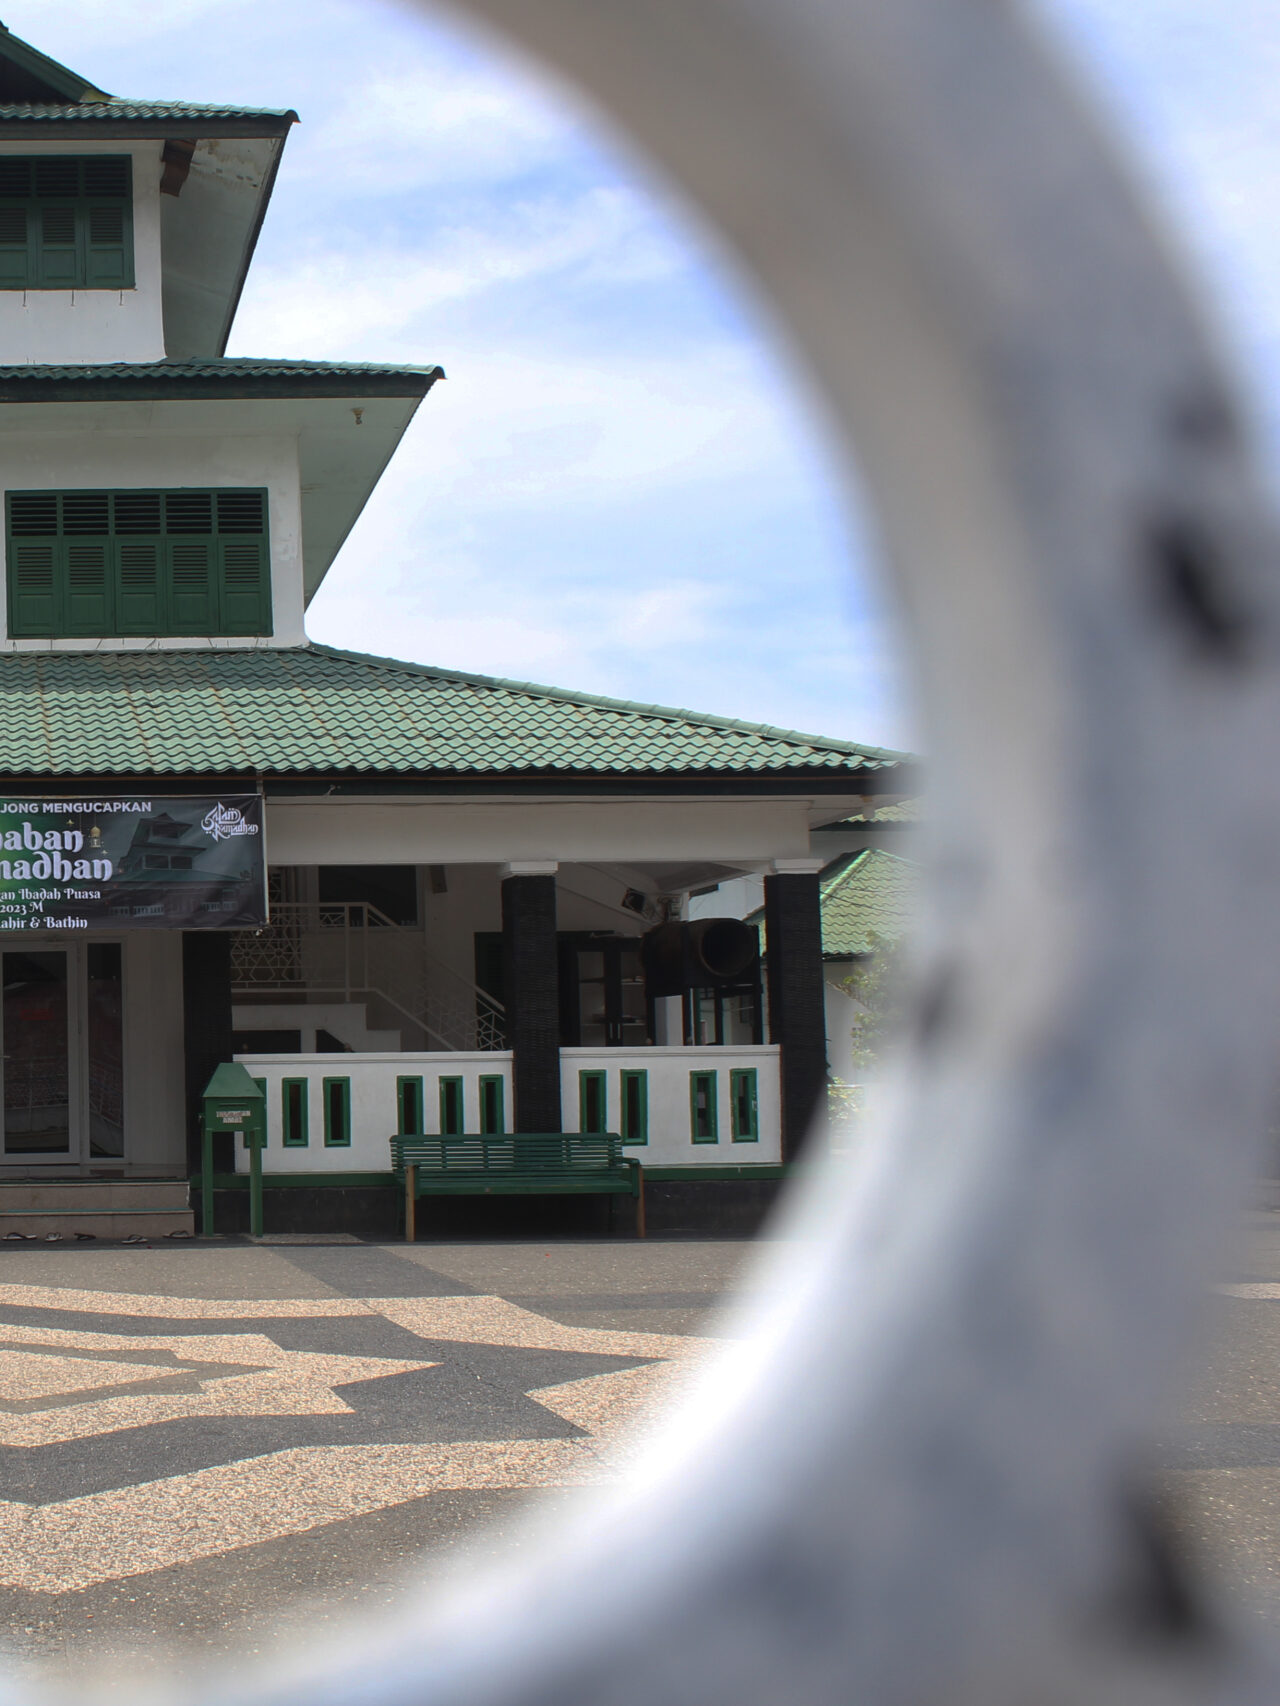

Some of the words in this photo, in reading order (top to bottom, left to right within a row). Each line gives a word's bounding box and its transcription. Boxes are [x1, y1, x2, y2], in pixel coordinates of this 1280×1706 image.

[42, 801, 152, 813] MENGUCAPKAN
[18, 887, 62, 901] Ibadah
[63, 887, 102, 900] Puasa
[0, 904, 27, 916] 2023
[28, 900, 45, 913] M
[29, 916, 41, 929] &
[43, 915, 88, 929] Bathin
